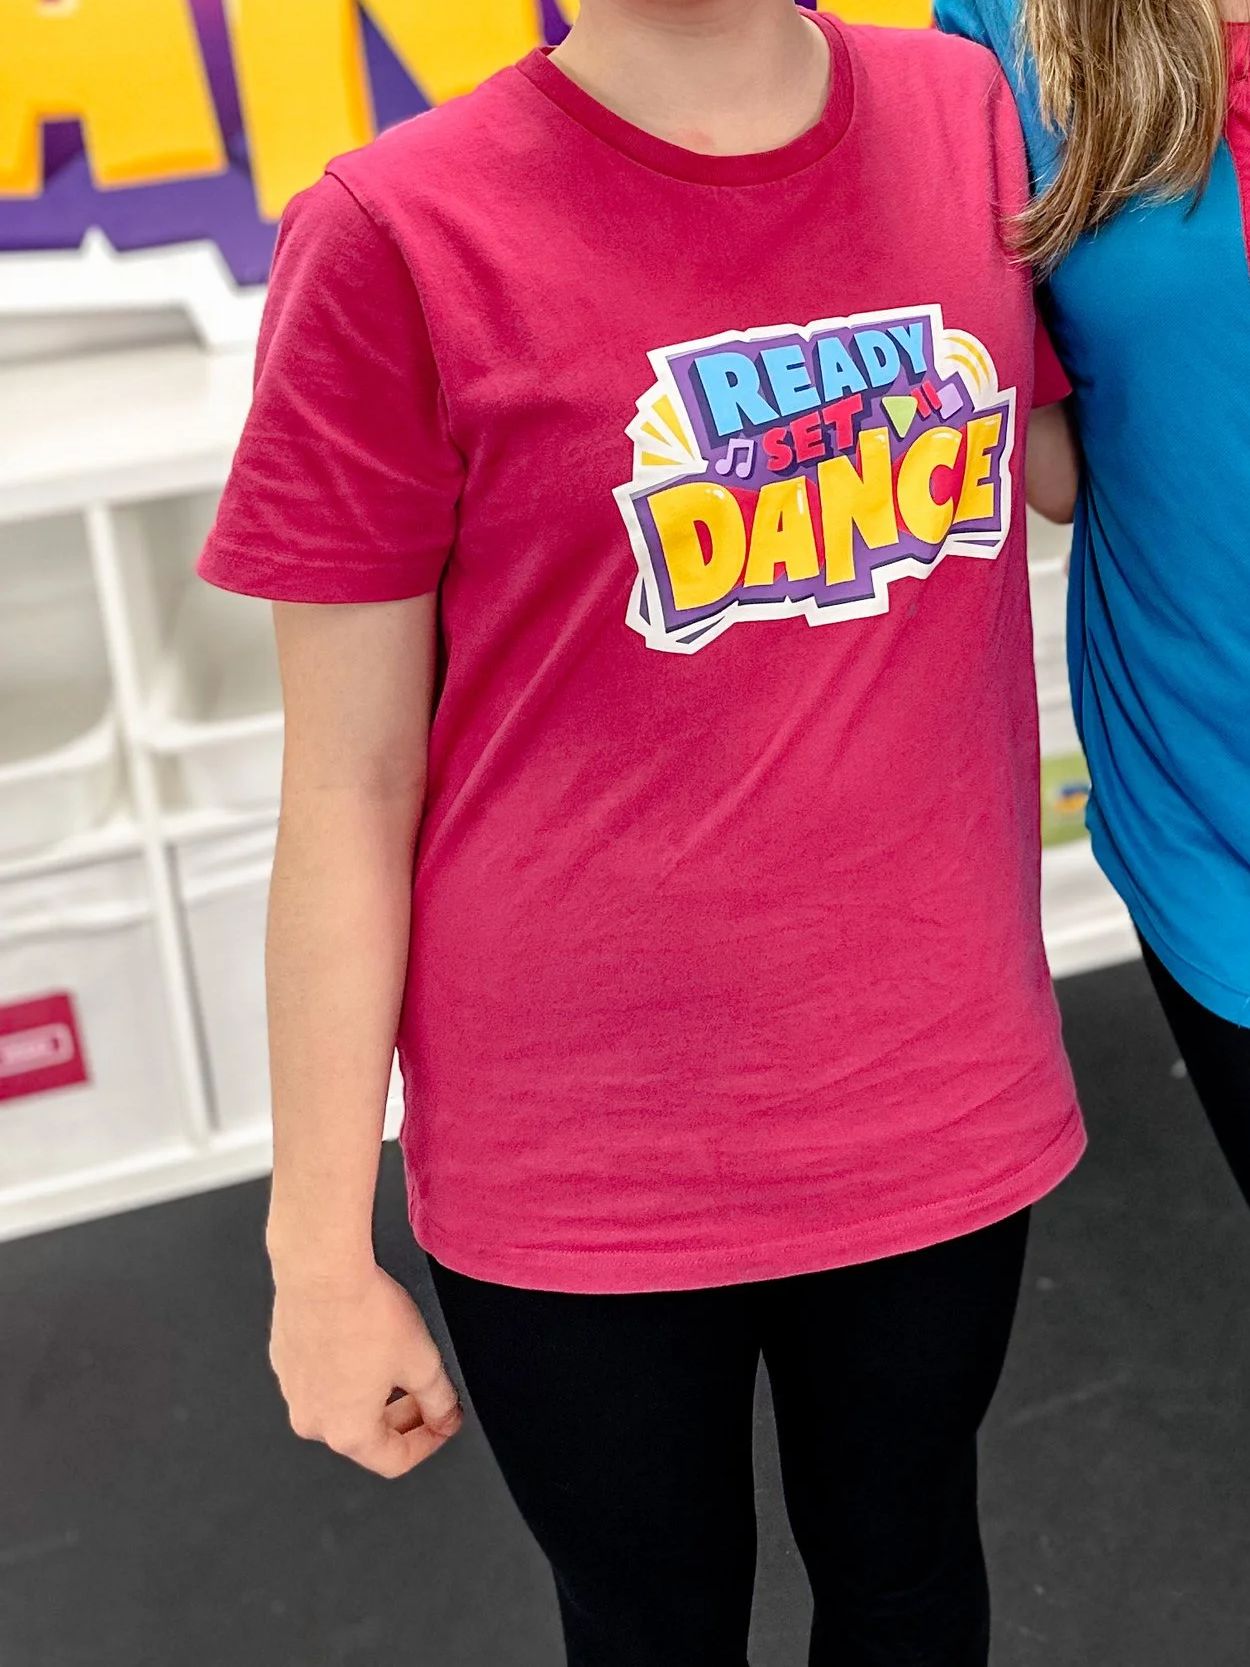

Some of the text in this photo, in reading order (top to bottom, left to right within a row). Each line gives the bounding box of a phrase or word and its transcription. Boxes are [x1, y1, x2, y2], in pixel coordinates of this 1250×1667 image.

[693, 322, 926, 437] READY
[762, 394, 864, 472] SET
[647, 413, 1003, 611] DANCE
